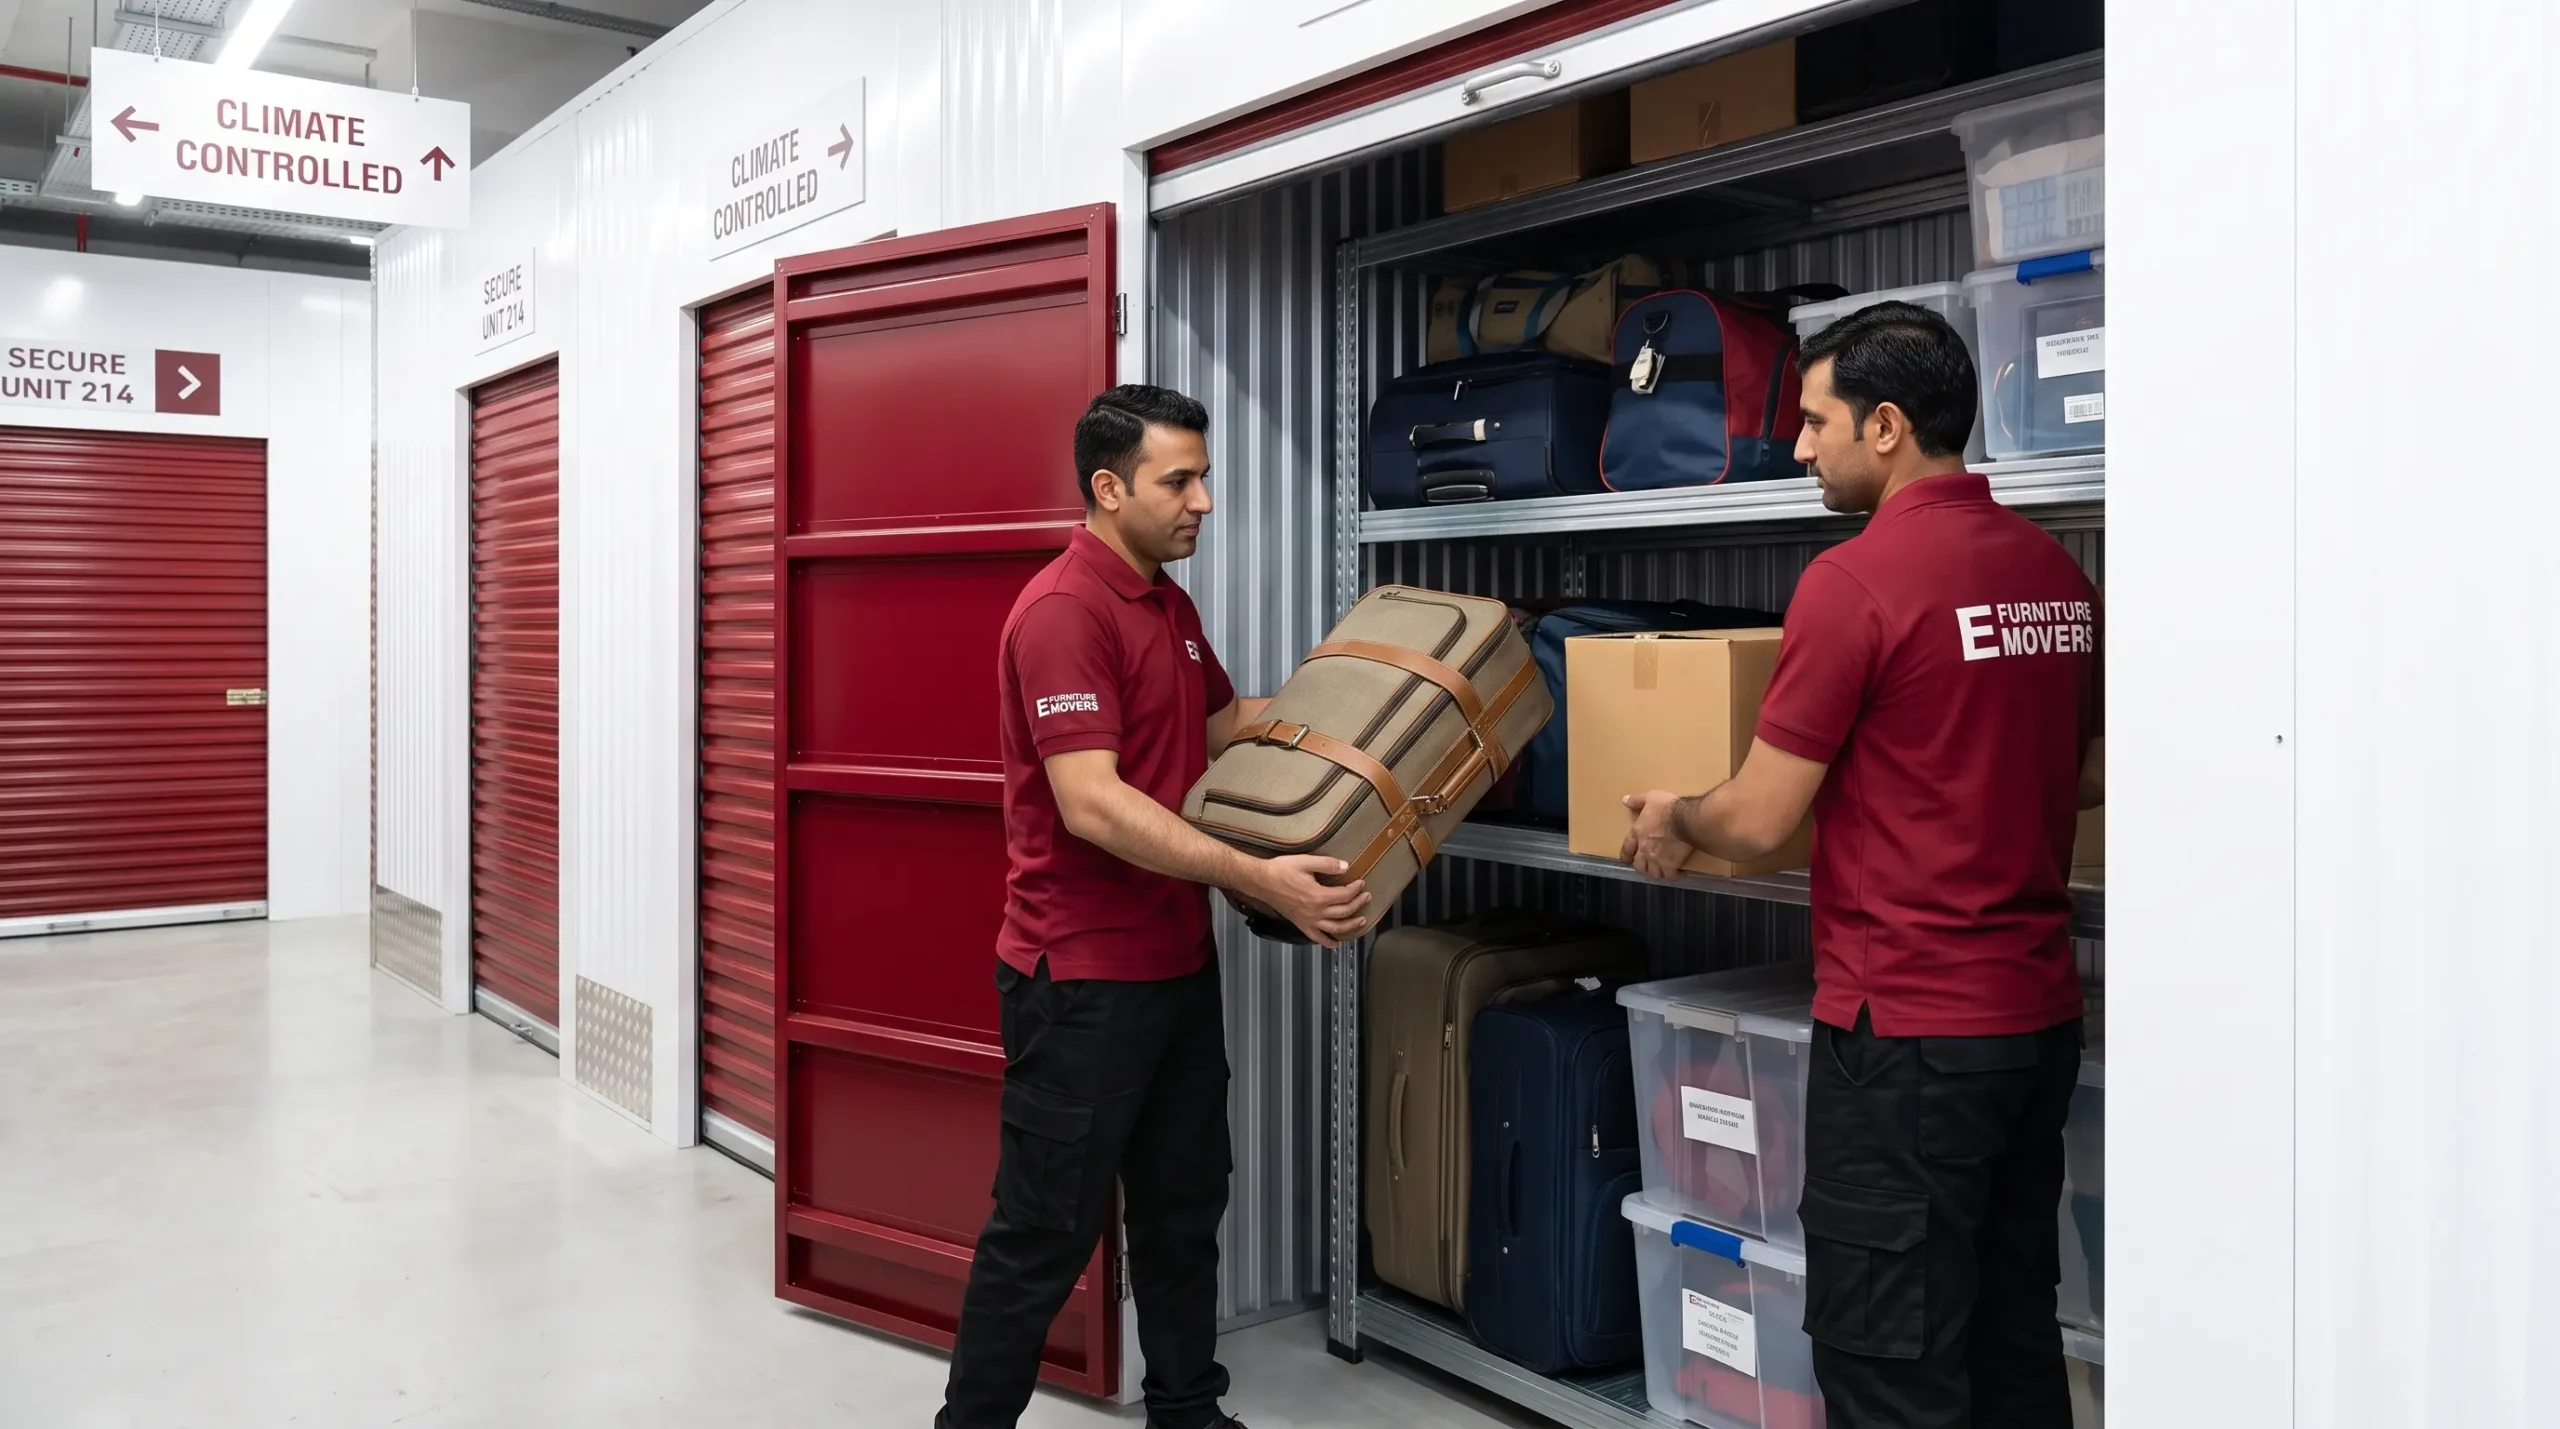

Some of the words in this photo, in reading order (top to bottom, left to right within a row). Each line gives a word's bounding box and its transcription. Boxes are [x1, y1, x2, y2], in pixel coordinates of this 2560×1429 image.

[217, 98, 365, 147] CLIMATE
[176, 139, 403, 194] CONTROLLED
[731, 127, 799, 188] CLIMATE
[713, 168, 818, 240] CONTROLLED
[483, 264, 522, 305] SECURE
[482, 307, 504, 340] UNIT
[507, 299, 524, 331] 214
[8, 347, 126, 375] SECURE
[1, 376, 72, 400] UNIT
[81, 381, 134, 404] 214
[1955, 604, 2000, 662] E
[1996, 601, 2092, 624] FURNITURE
[2001, 624, 2093, 657] MOVERS
[1036, 697, 1050, 718] E
[1049, 693, 1097, 703] FURNITURE
[1050, 701, 1099, 714] MOVERS
